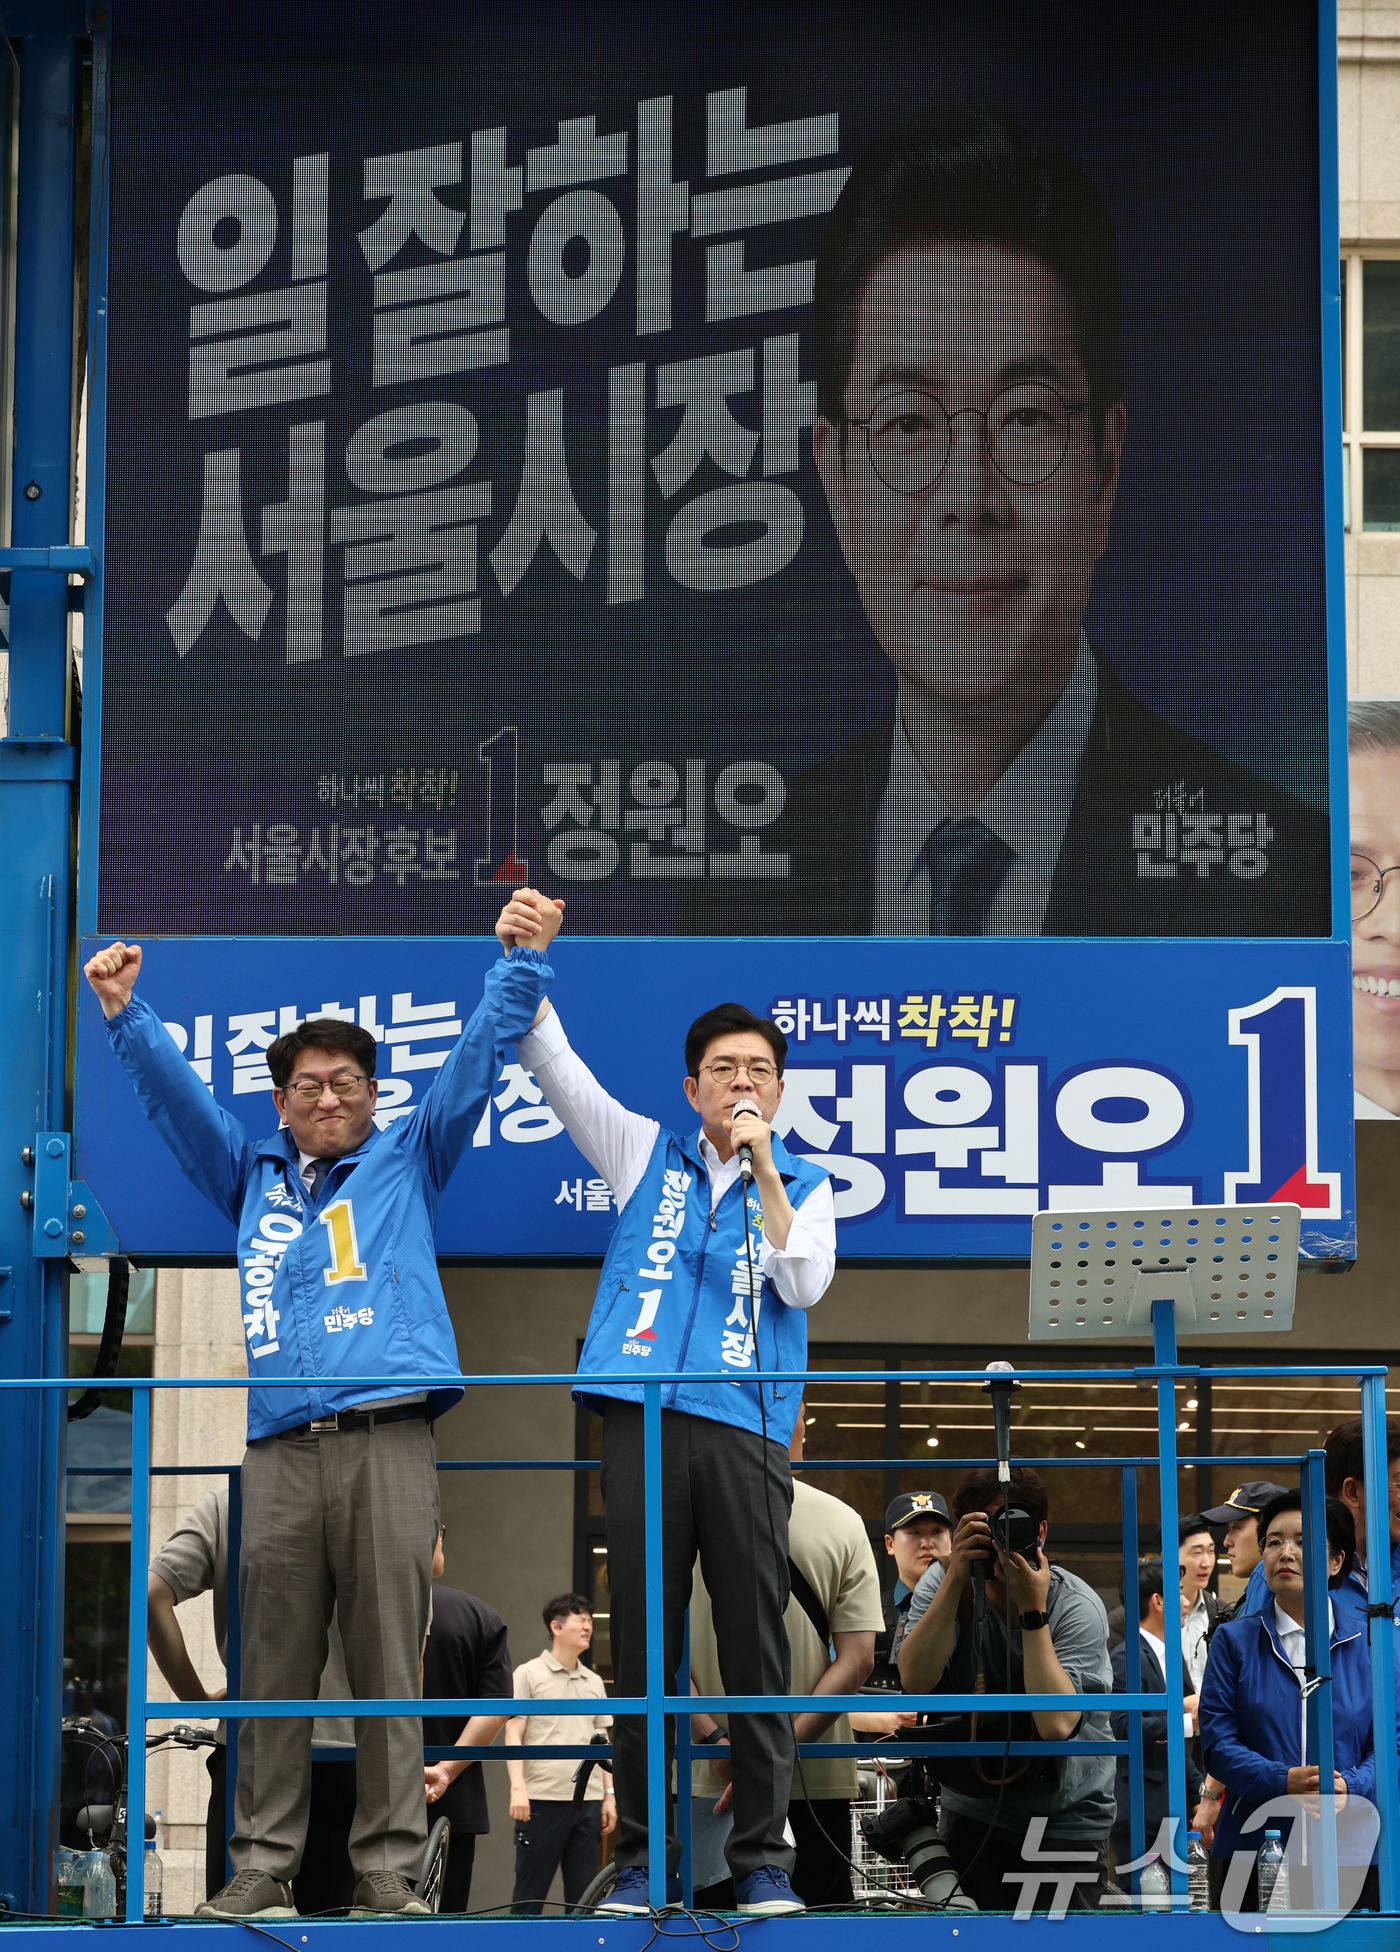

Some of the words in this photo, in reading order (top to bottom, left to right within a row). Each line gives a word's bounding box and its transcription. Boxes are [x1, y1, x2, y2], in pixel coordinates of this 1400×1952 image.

[165, 332, 819, 664] 서울시장
[540, 758, 791, 881] 정원오
[1132, 812, 1275, 879] 민주당
[771, 999, 891, 1042] 하나씩
[897, 994, 1016, 1048] 착착!
[782, 1064, 1194, 1219] 정원오
[1223, 986, 1341, 1220] 1
[554, 1178, 618, 1212] 서울
[638, 1168, 693, 1281] 정원오
[319, 1198, 368, 1287] 1
[323, 1306, 375, 1334] 민주당
